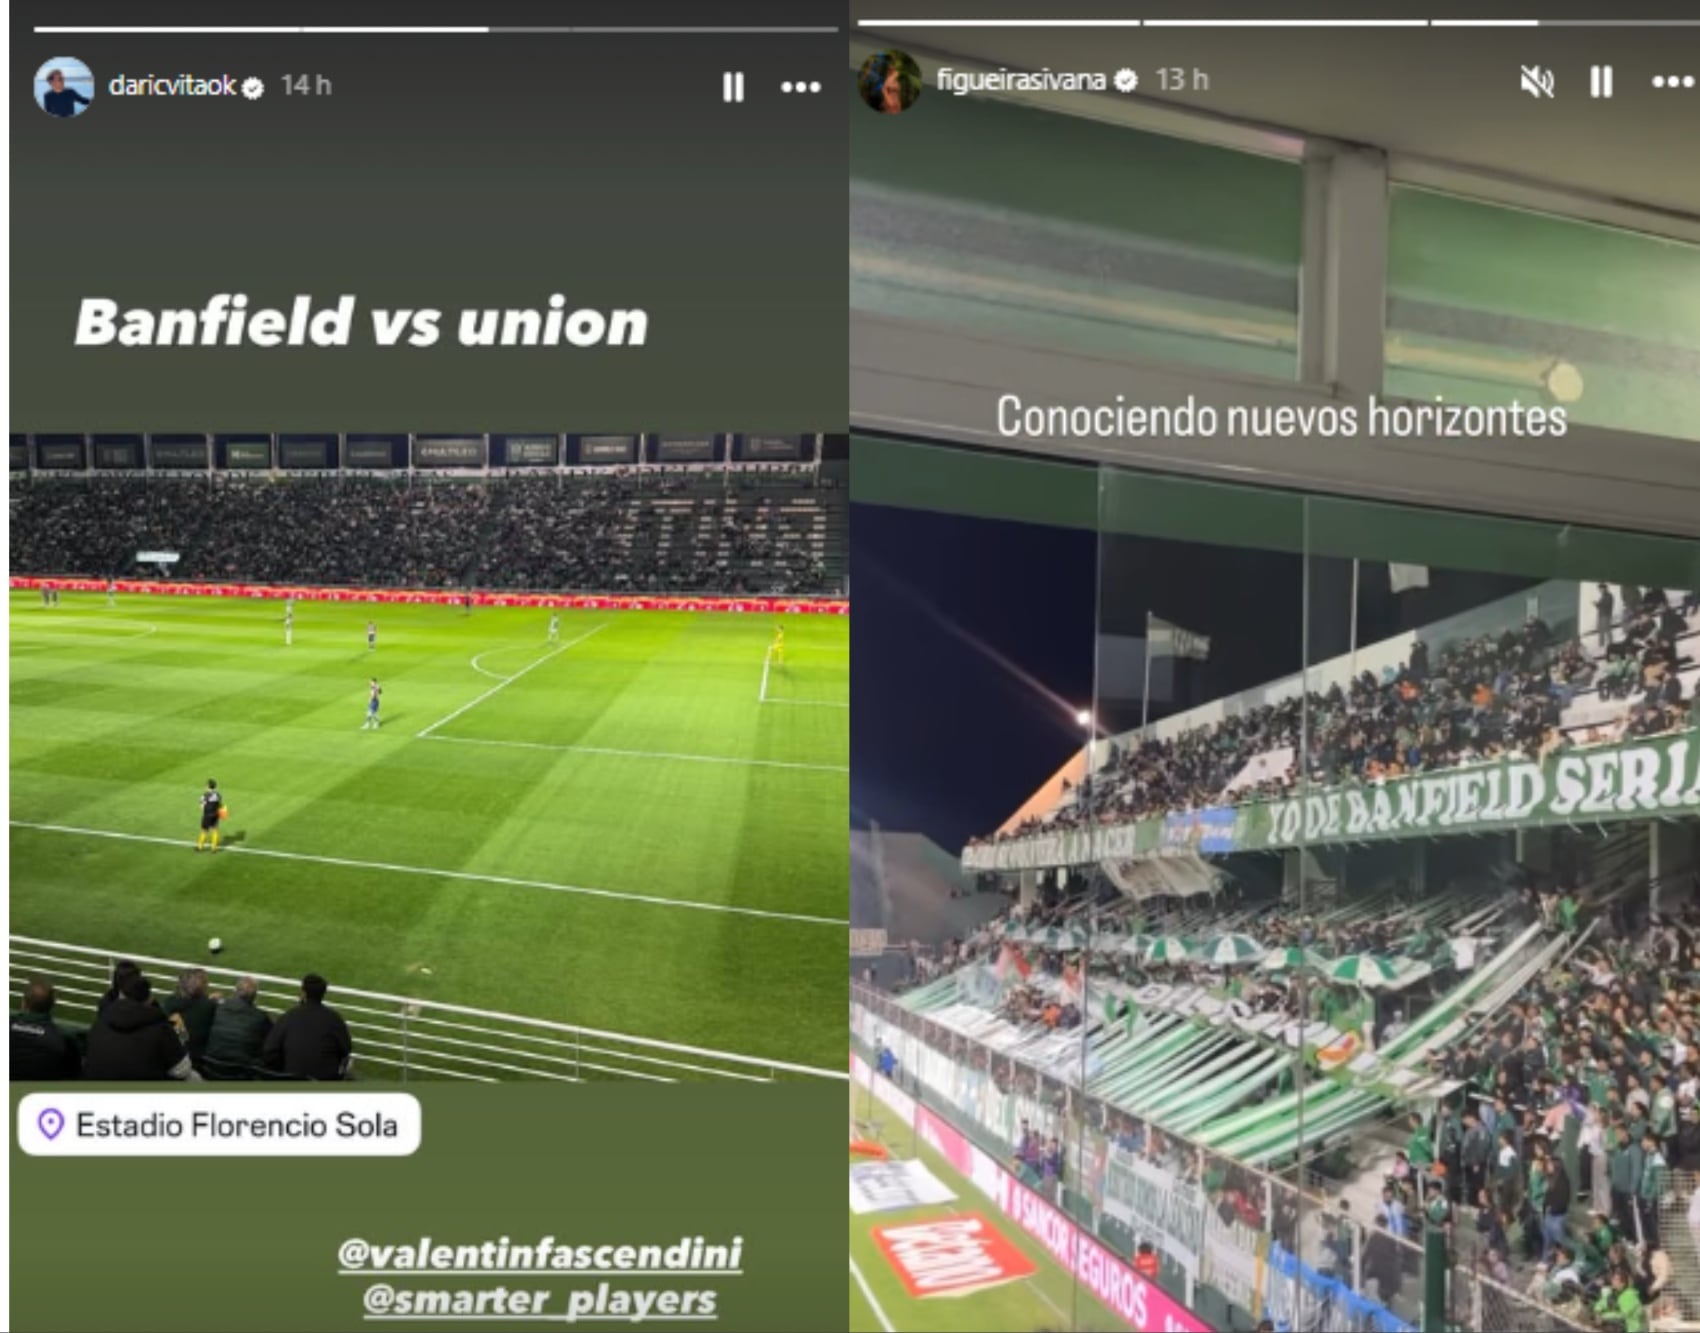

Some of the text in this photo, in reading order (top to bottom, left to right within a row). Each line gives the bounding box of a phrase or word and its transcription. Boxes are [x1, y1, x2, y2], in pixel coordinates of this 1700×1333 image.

[1304, 792, 1342, 841] DE
[1344, 762, 1546, 836] BANFIELD
[1549, 738, 1700, 816] SERI
